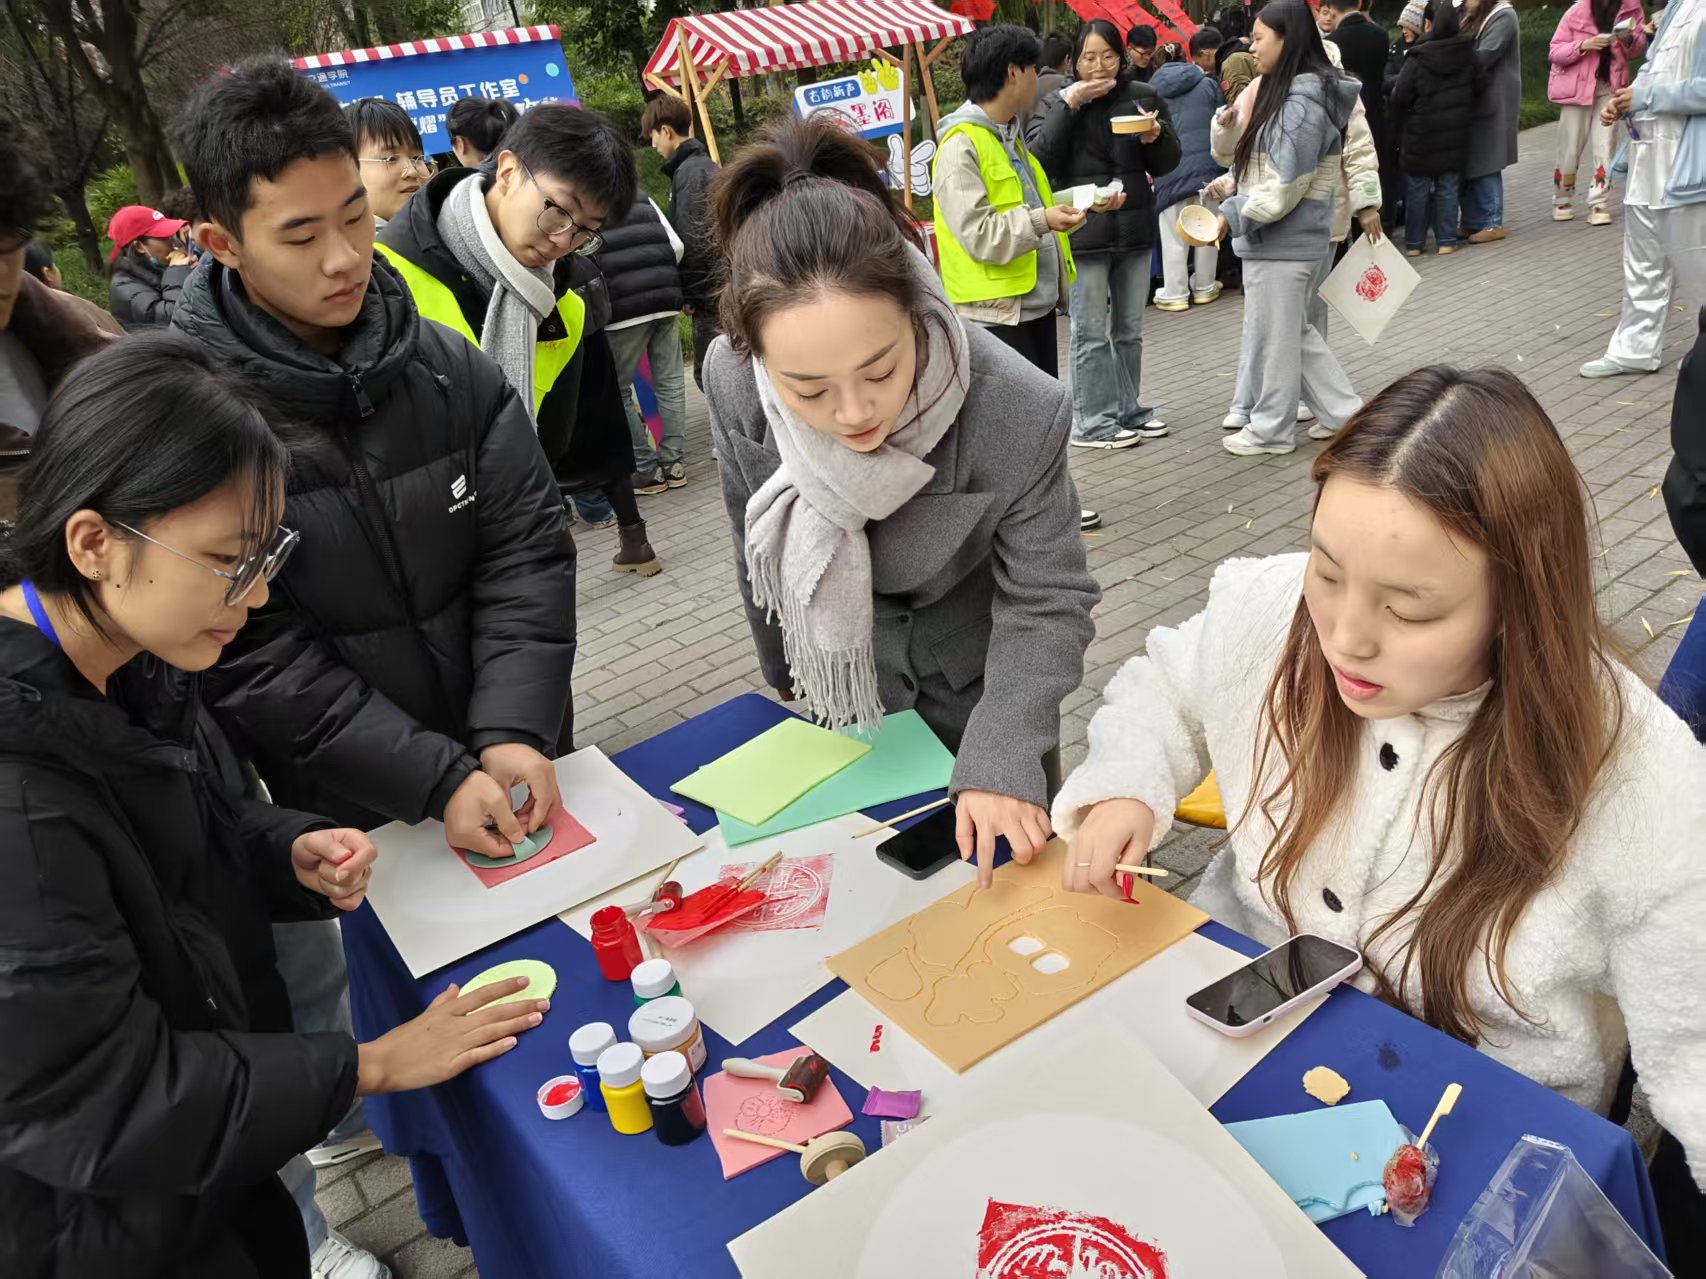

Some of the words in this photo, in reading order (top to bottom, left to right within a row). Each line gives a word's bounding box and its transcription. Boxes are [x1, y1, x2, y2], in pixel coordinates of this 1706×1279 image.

[396, 78, 520, 110] 辅导员工作室
[808, 82, 855, 103] 古韵新声
[832, 98, 895, 127] 墨阁
